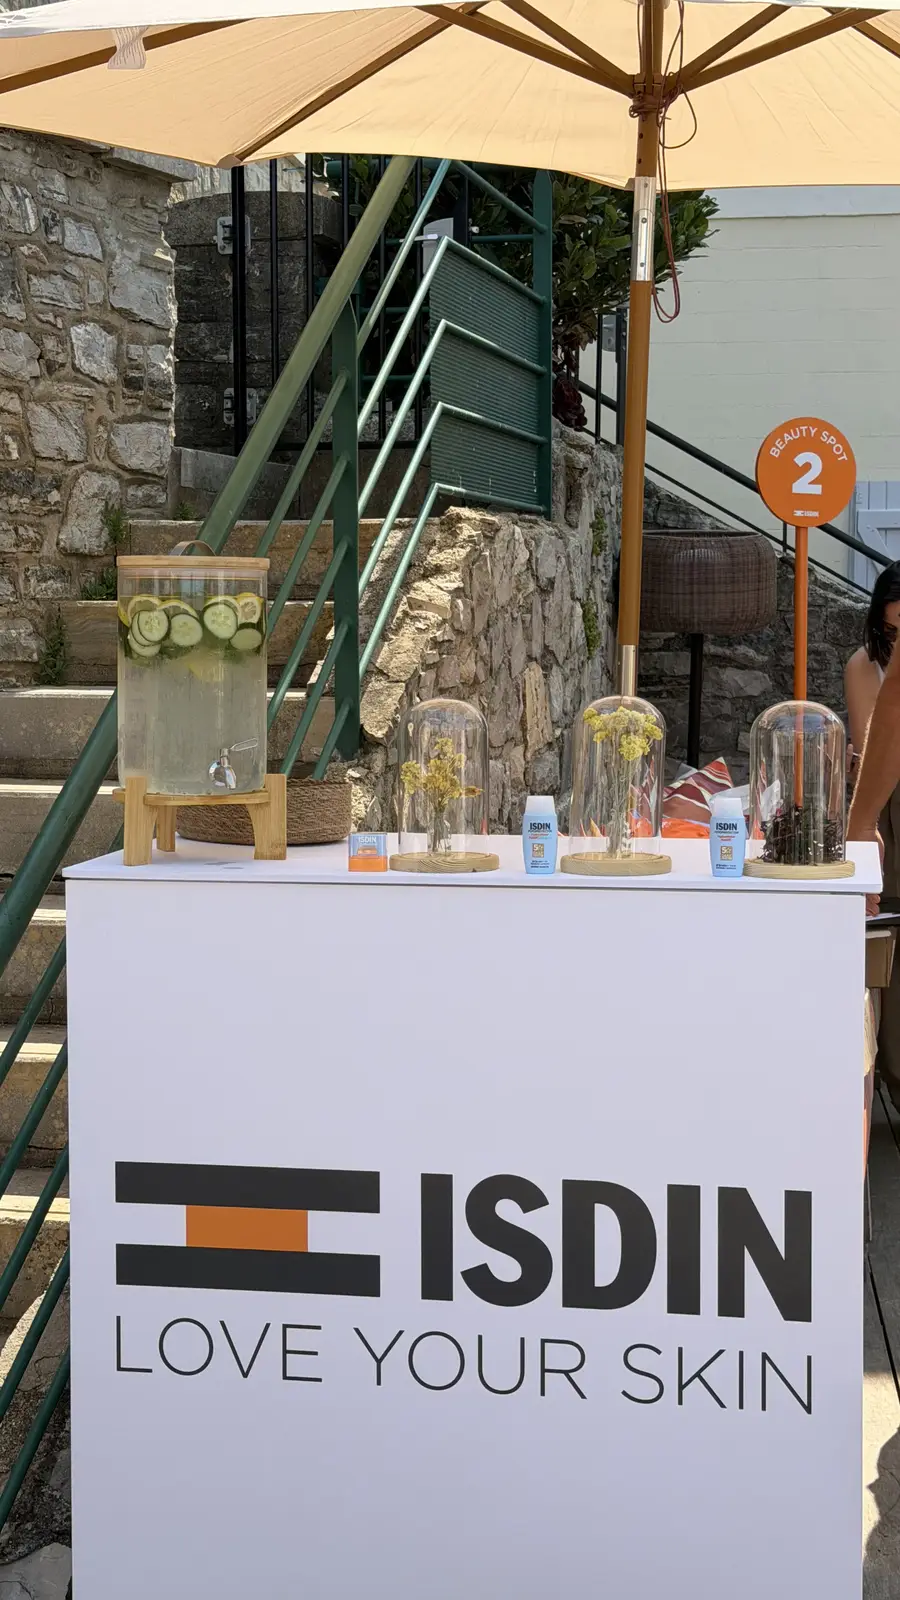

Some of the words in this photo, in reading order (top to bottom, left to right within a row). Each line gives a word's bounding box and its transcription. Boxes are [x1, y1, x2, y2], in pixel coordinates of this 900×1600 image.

[769, 426, 818, 458] BEAUTY
[820, 430, 848, 461] SPOT
[792, 451, 822, 495] 2
[529, 822, 551, 830] ISDIN
[715, 822, 738, 831] ISDIN
[421, 1173, 813, 1323] ISDIN
[116, 1316, 323, 1383] LOVE
[354, 1328, 588, 1400] YOUR
[622, 1344, 812, 1415] SKIN
